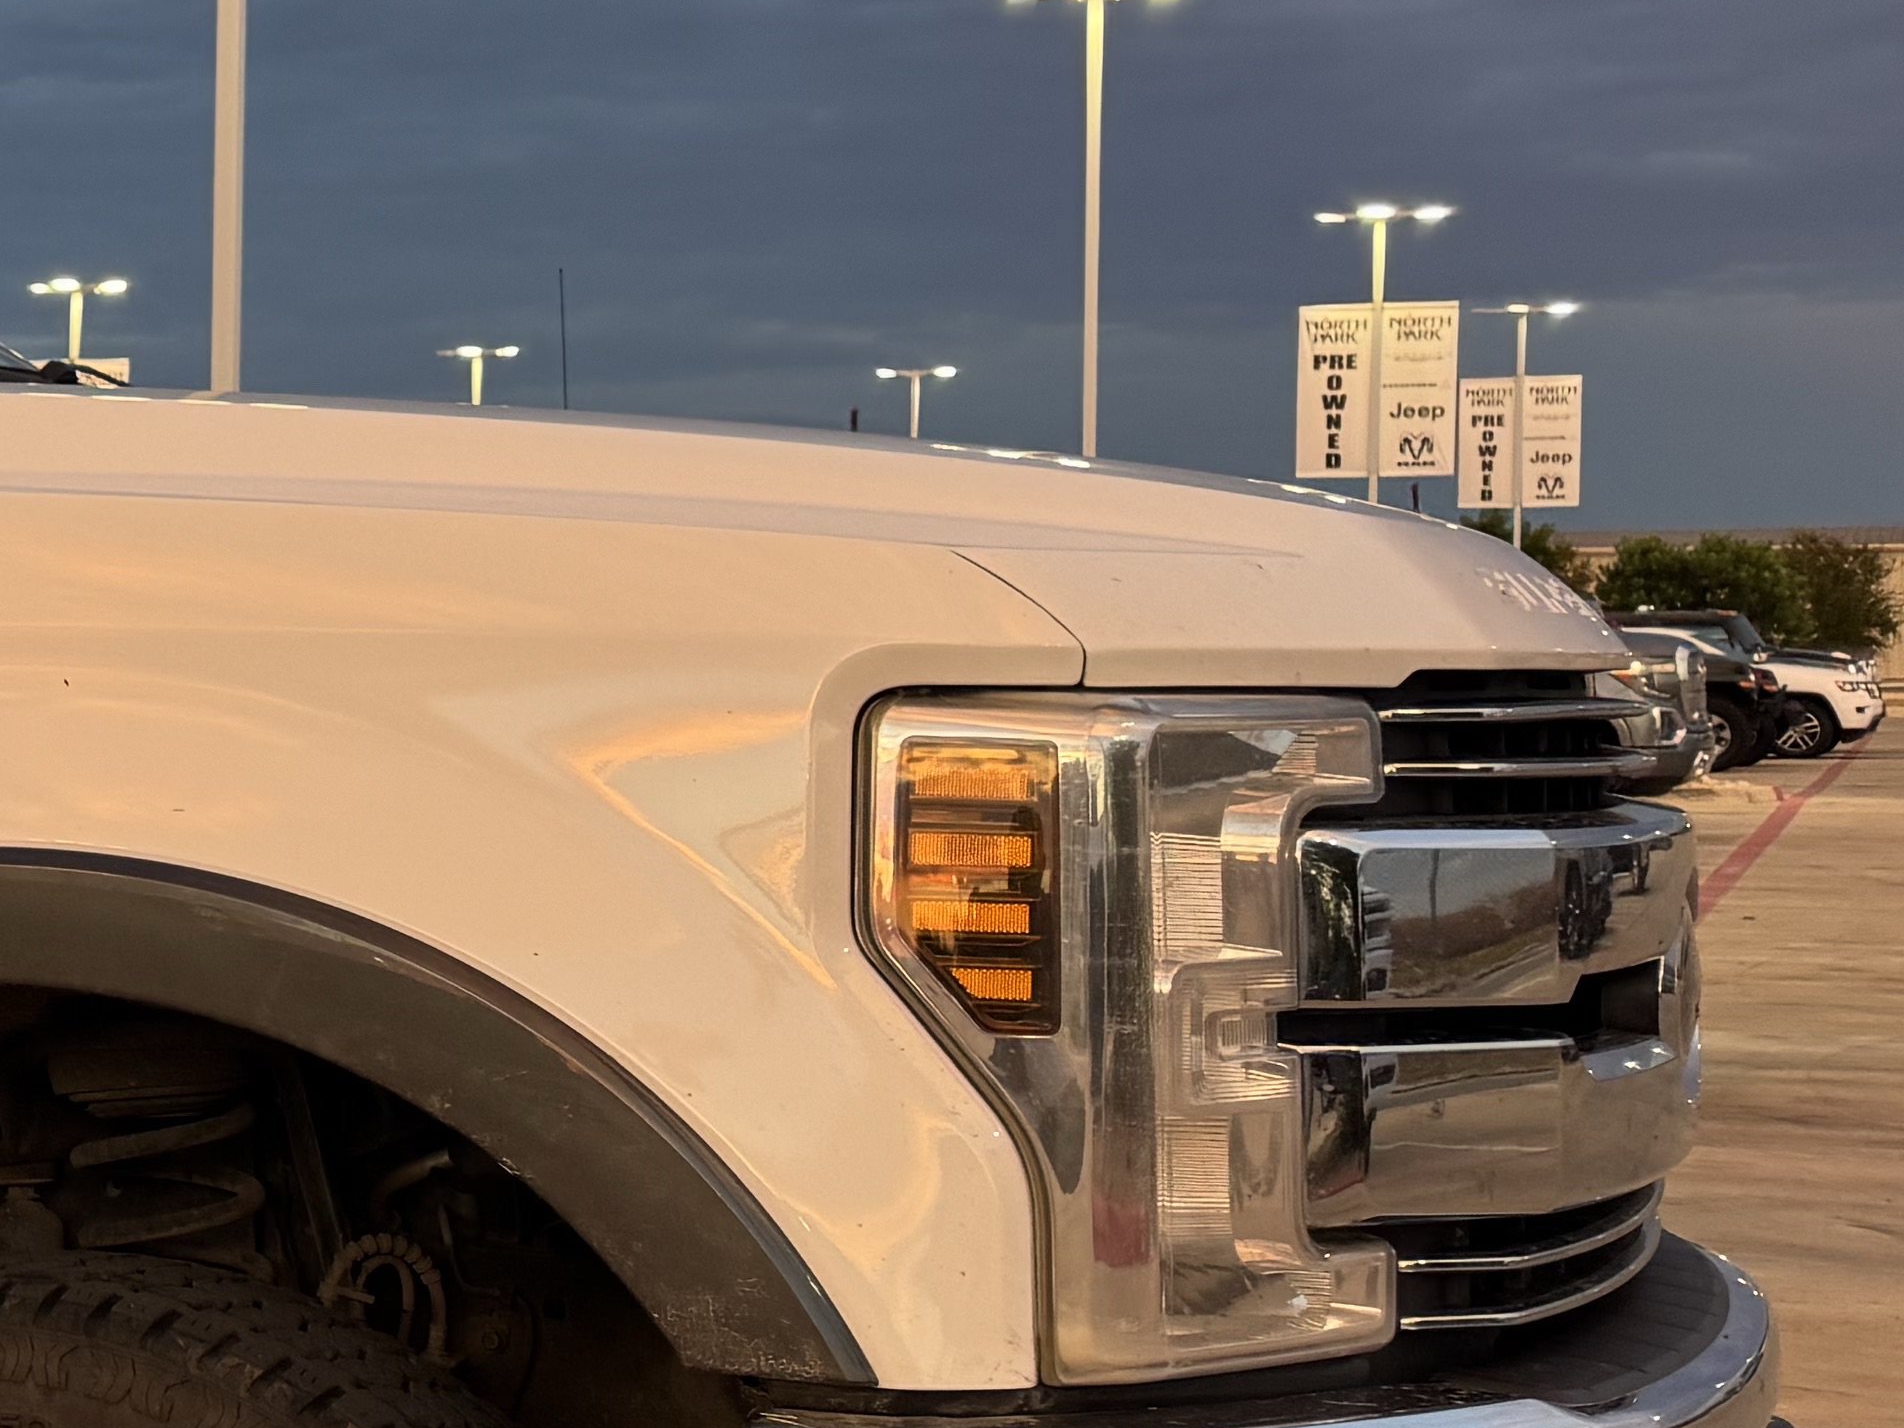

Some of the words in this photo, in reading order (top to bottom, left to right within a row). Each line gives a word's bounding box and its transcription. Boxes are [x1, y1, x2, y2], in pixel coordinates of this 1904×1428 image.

[1313, 354, 1357, 370] PRE
[1389, 402, 1445, 422] Jeep
[1530, 450, 1573, 465] Jeep
